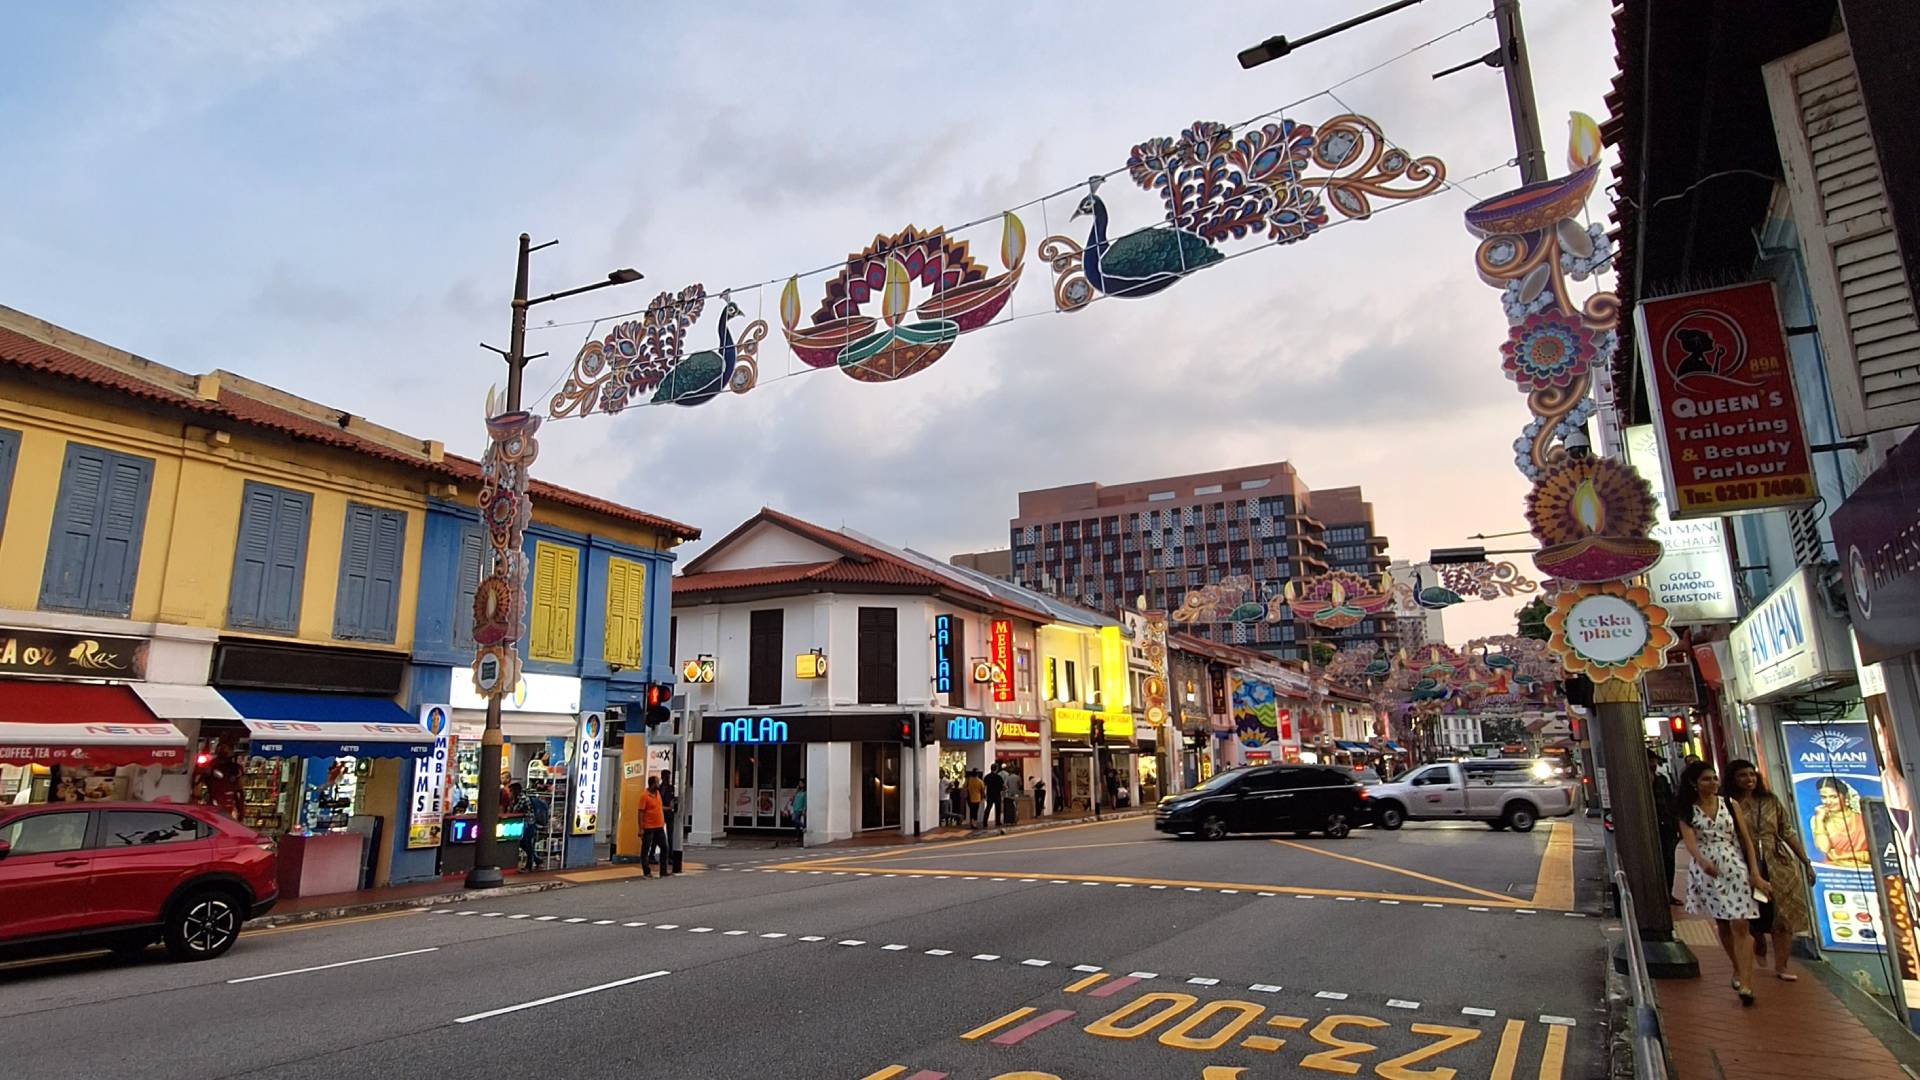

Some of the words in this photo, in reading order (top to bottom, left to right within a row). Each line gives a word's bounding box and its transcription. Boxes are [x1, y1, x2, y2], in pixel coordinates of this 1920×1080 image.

[1676, 418, 1789, 441] Tailoring
[1681, 447, 1699, 462] &
[1704, 439, 1791, 460] Beauty
[1692, 461, 1787, 480] Parlour
[1664, 535, 1721, 549] RCHALAI
[1669, 571, 1702, 582] GOLD
[1659, 580, 1716, 592] DIAMOND
[1661, 591, 1723, 604] GEMSTONE
[1578, 614, 1632, 628] tekka
[1579, 627, 1633, 643] place
[85, 726, 171, 735] NETS
[255, 722, 322, 732] NETS
[363, 724, 422, 733] NETS
[152, 750, 176, 758] NETS
[1800, 751, 1826, 762] ANI
[1828, 751, 1868, 762] MANI
[432, 737, 448, 812] MOBILE
[578, 740, 590, 805] OHMS
[590, 741, 602, 805] MOBILE
[416, 757, 430, 812] HMS
